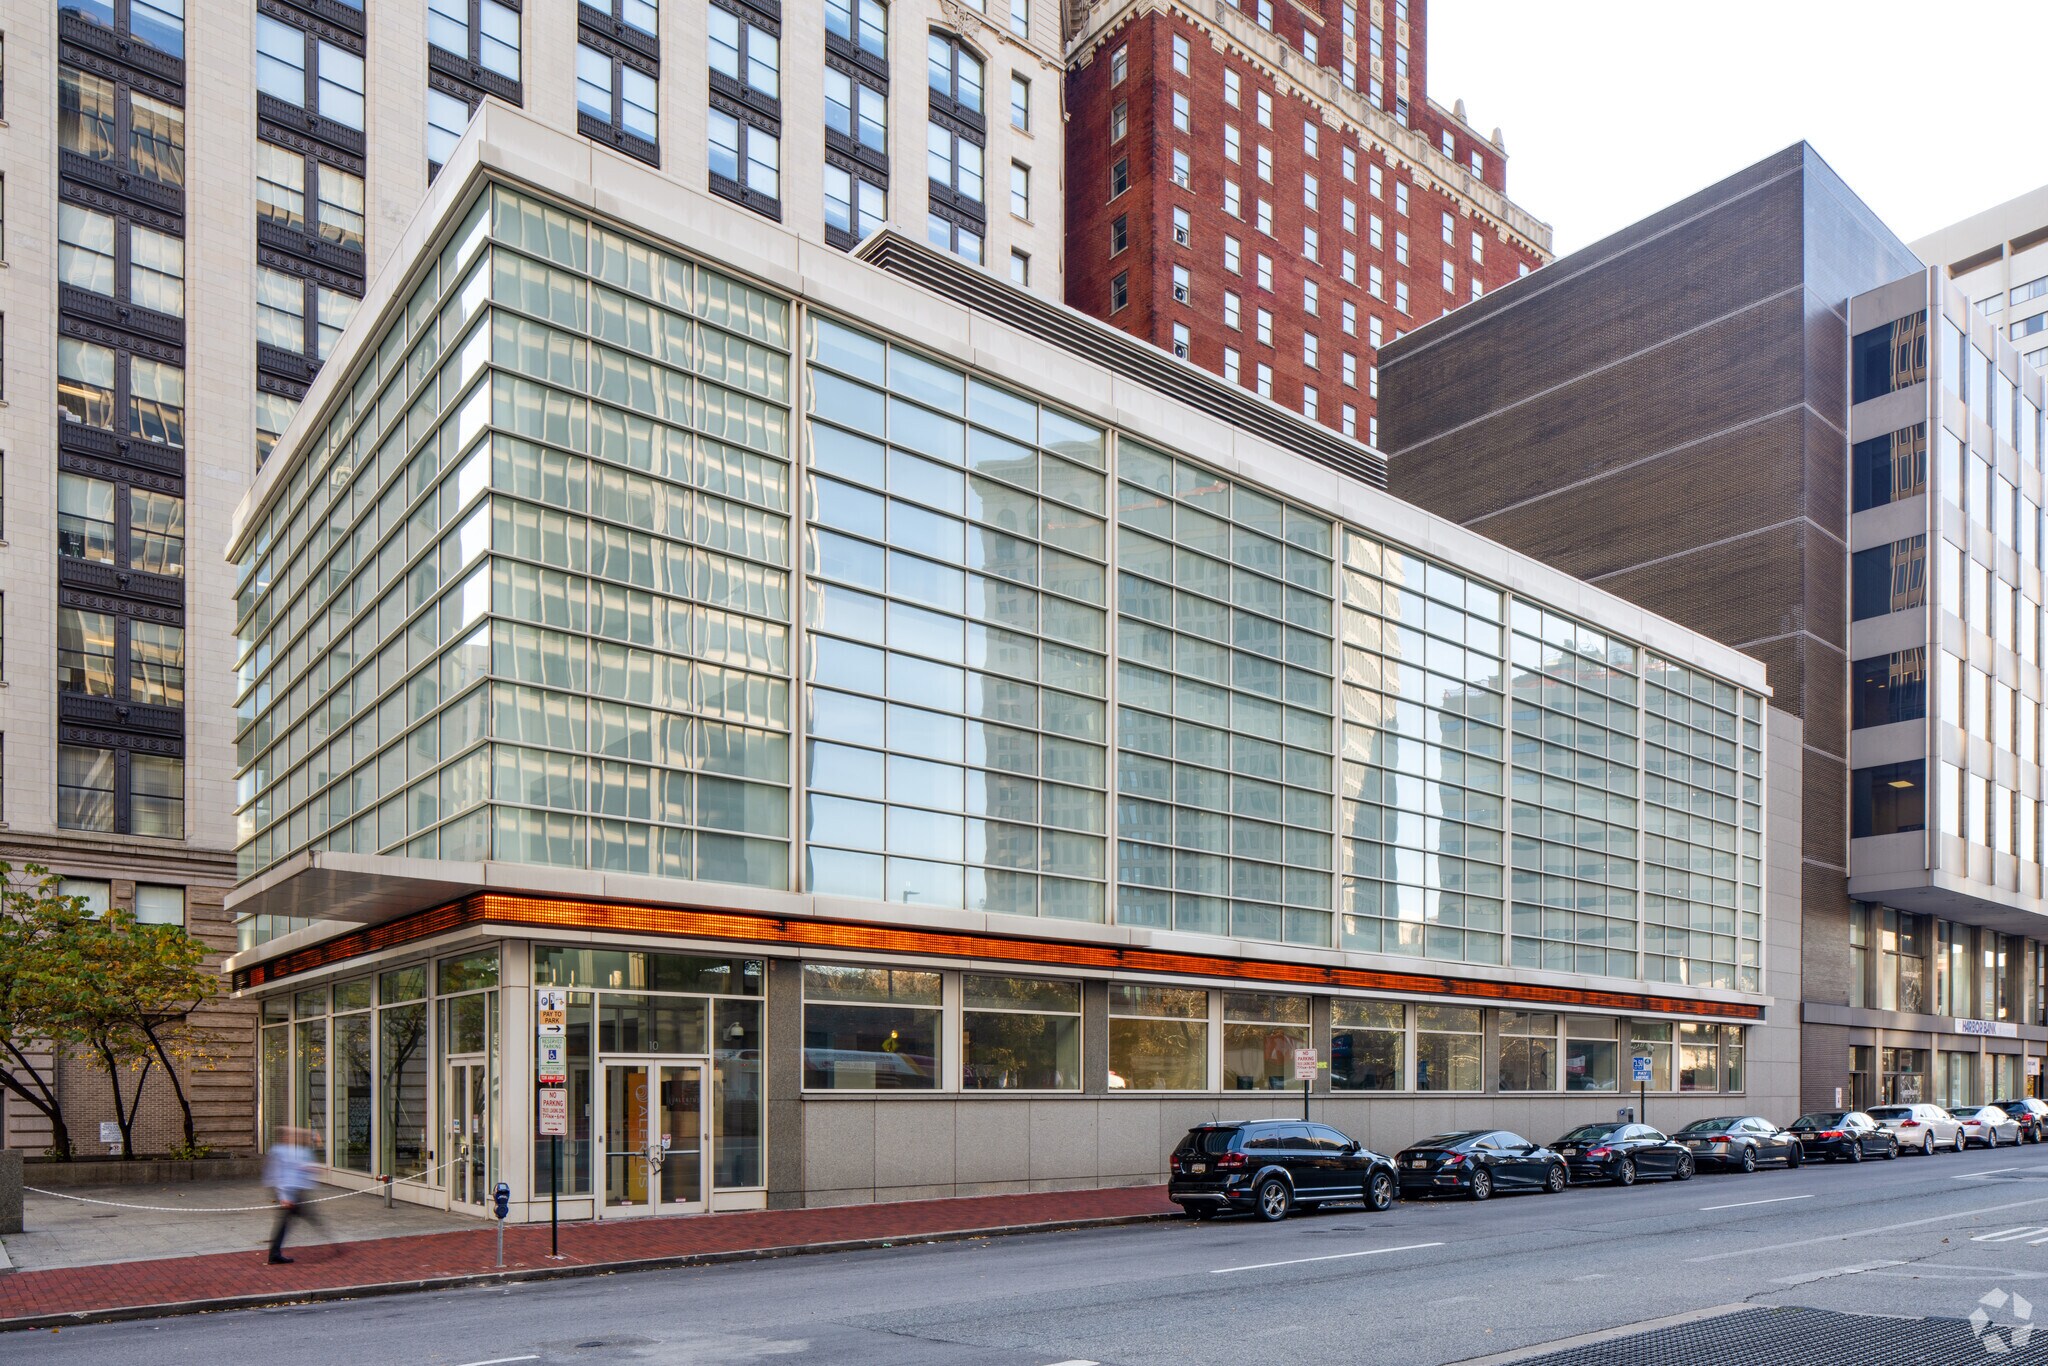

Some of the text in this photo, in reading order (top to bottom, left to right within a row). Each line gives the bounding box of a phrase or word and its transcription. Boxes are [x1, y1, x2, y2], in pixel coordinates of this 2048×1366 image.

[1962, 1020, 1983, 1033] HARBOR
[1984, 1022, 1997, 1034] BANK
[649, 1041, 659, 1050] 10
